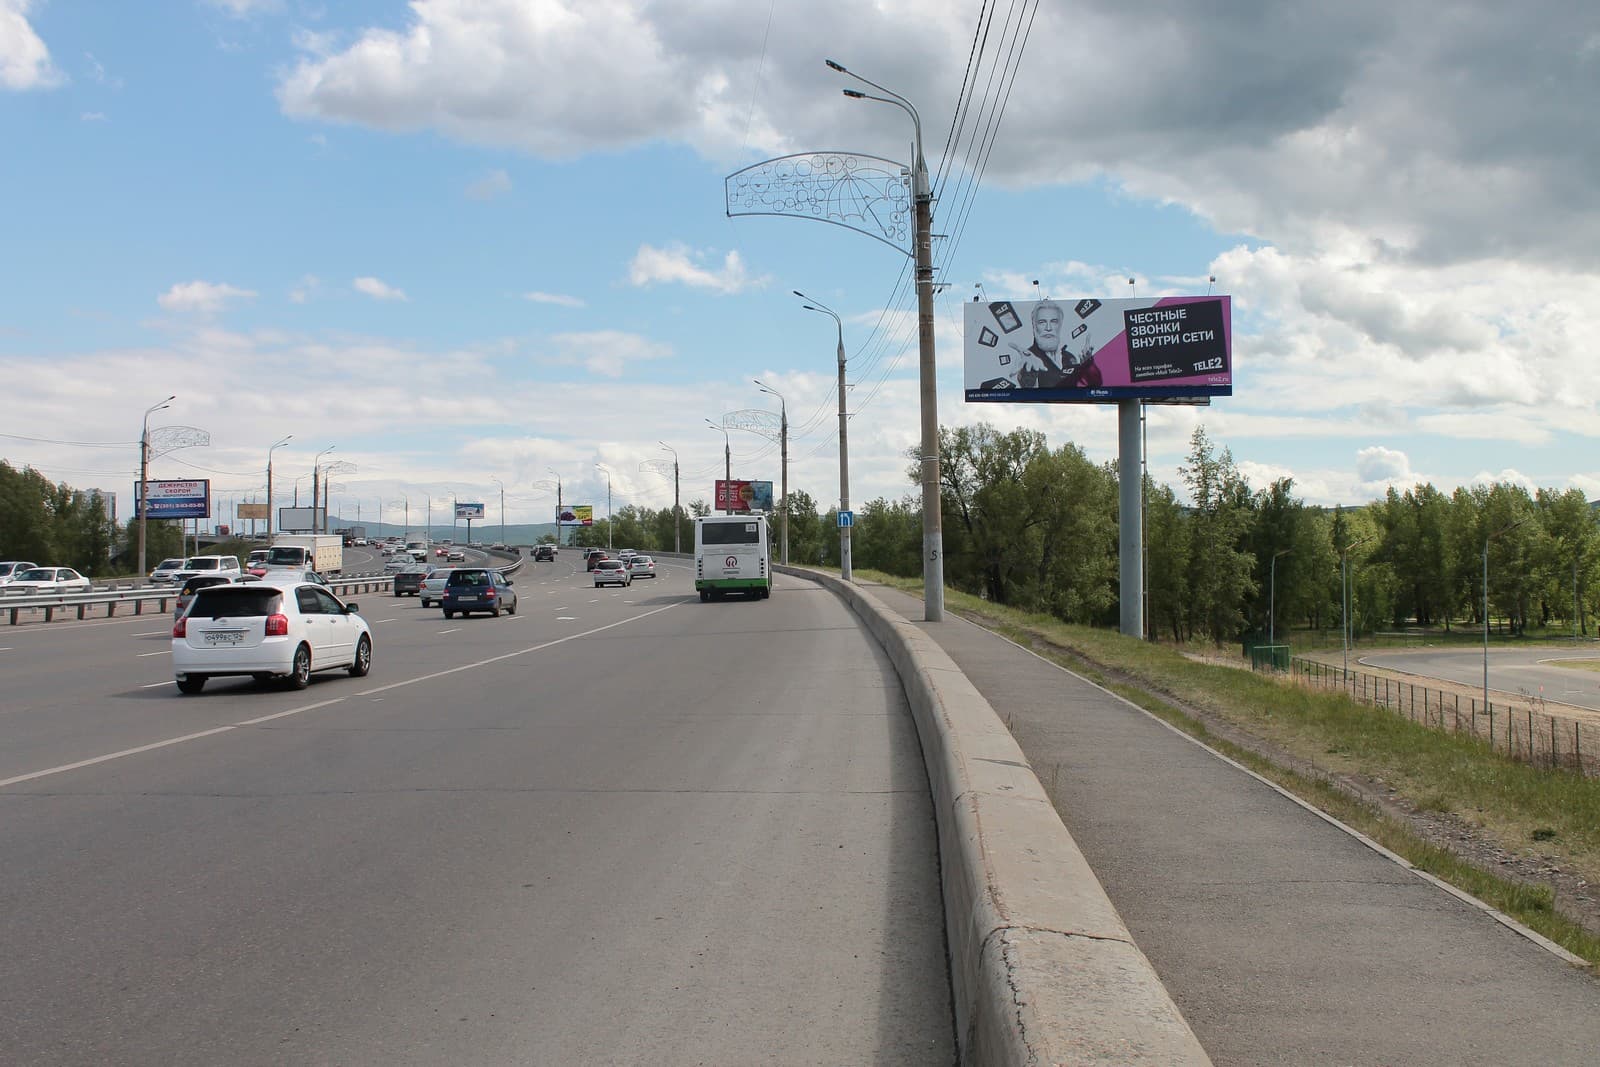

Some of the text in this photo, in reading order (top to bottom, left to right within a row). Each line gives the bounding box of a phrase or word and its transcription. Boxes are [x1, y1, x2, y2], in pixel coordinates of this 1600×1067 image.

[1129, 309, 1187, 323] ЧЕСТНЫЕ
[1130, 321, 1181, 337] ЗВОНКИ
[1131, 329, 1214, 349] ВНУТРИ СЕТИ
[1193, 356, 1223, 372] TELE2
